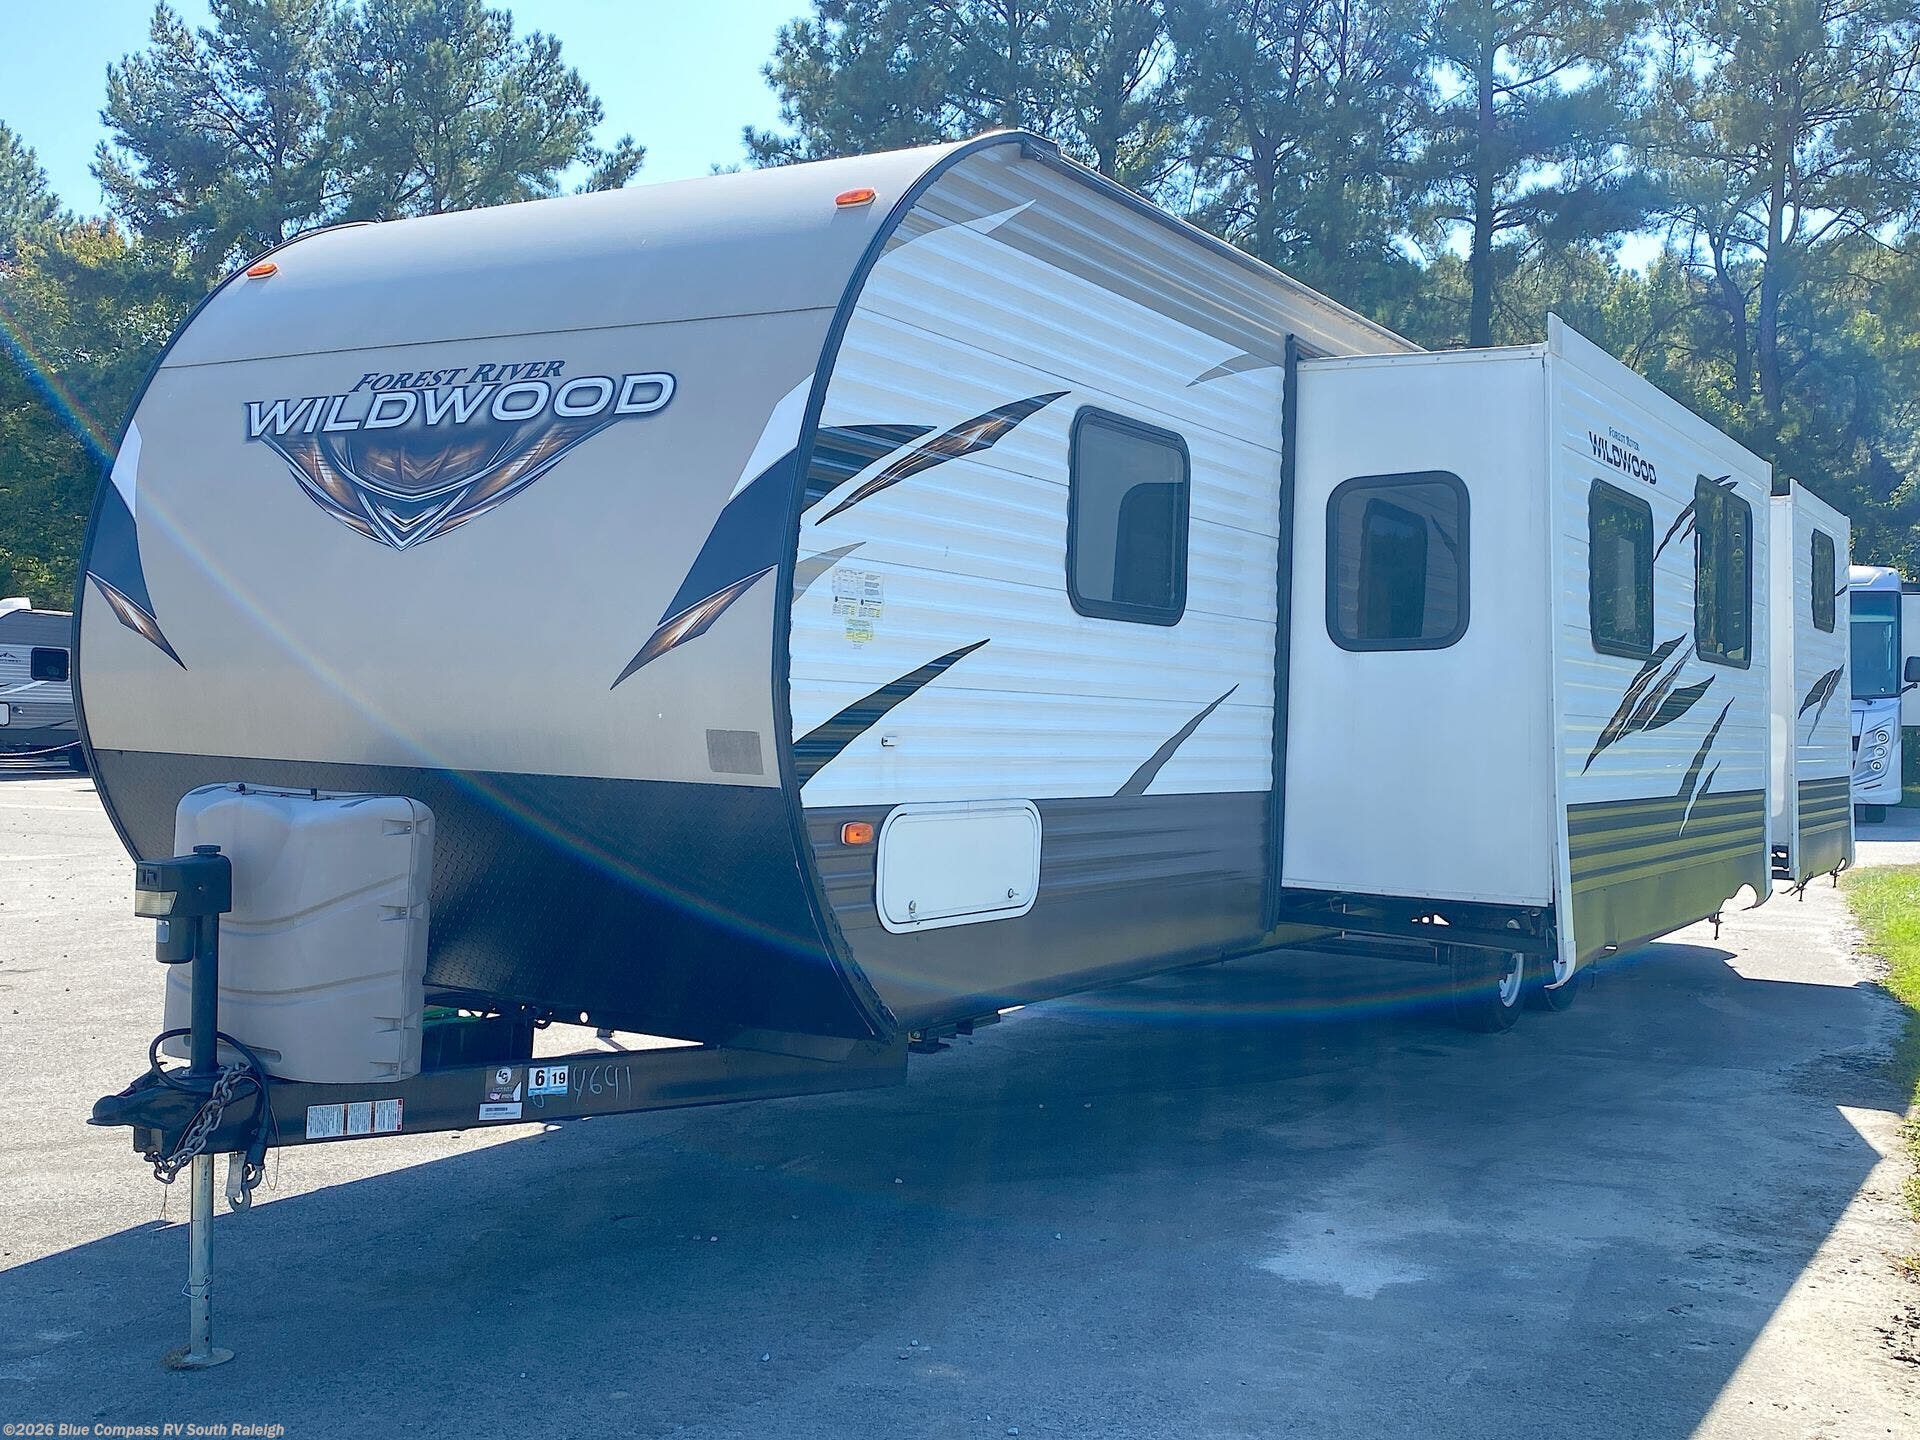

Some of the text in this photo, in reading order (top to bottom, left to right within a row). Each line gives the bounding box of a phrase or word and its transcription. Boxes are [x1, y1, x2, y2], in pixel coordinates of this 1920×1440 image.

[349, 360, 566, 393] FOREST RIVER
[244, 371, 678, 440] WILDWOOD
[1588, 430, 1657, 485] WILDWOOD
[535, 1069, 567, 1087] 6 19
